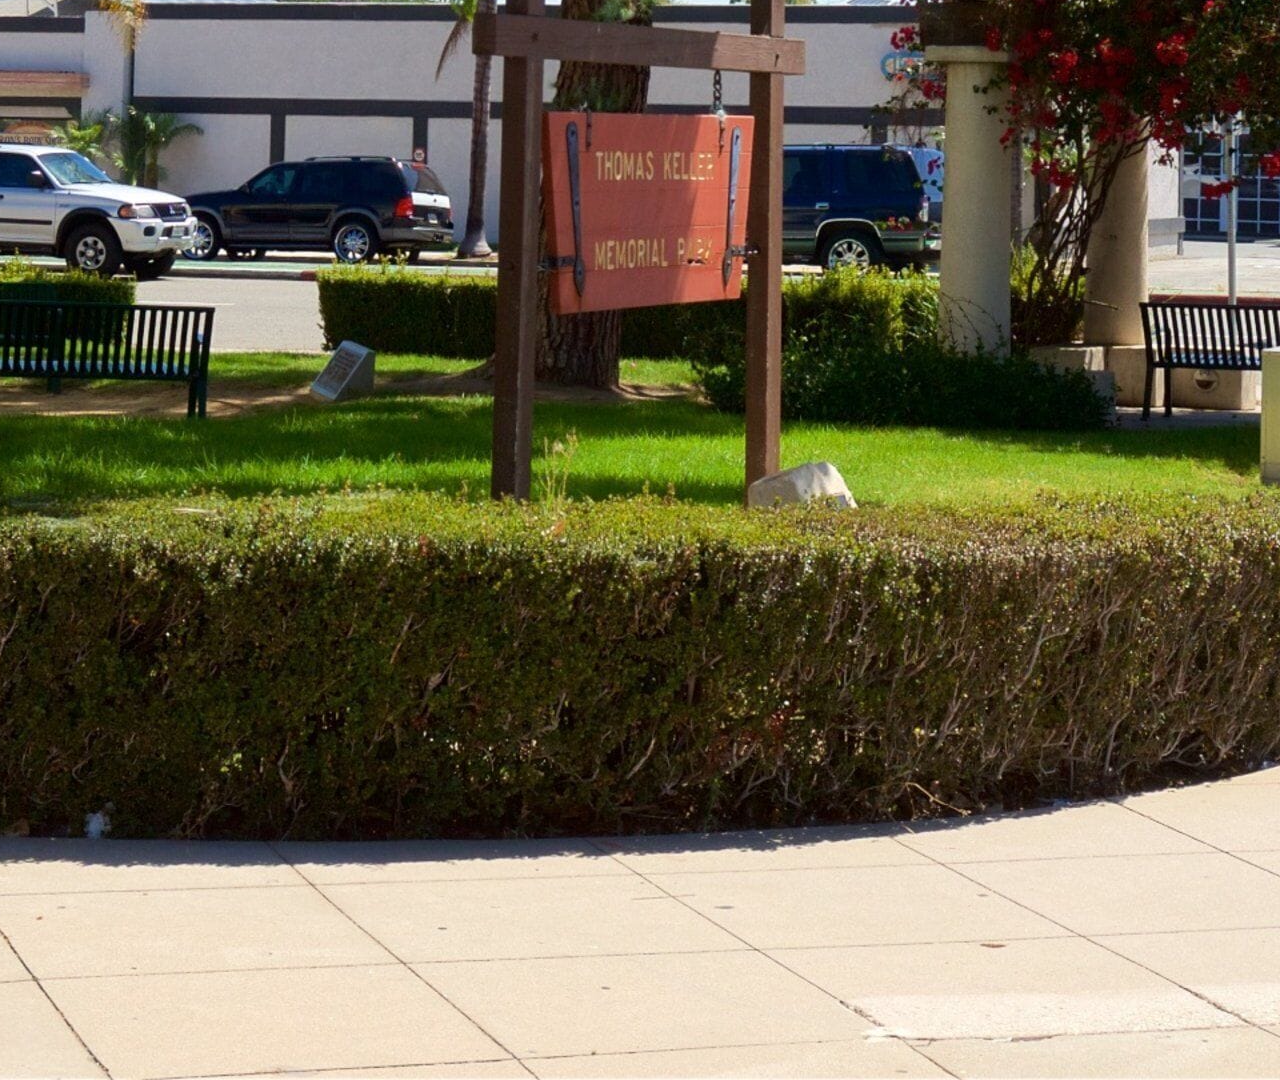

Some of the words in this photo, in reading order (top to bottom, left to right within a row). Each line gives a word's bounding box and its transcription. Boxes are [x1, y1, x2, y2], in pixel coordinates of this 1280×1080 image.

[596, 151, 655, 181] THOMAS
[663, 152, 715, 181] KELLER
[594, 238, 669, 271] MEMORIAL
